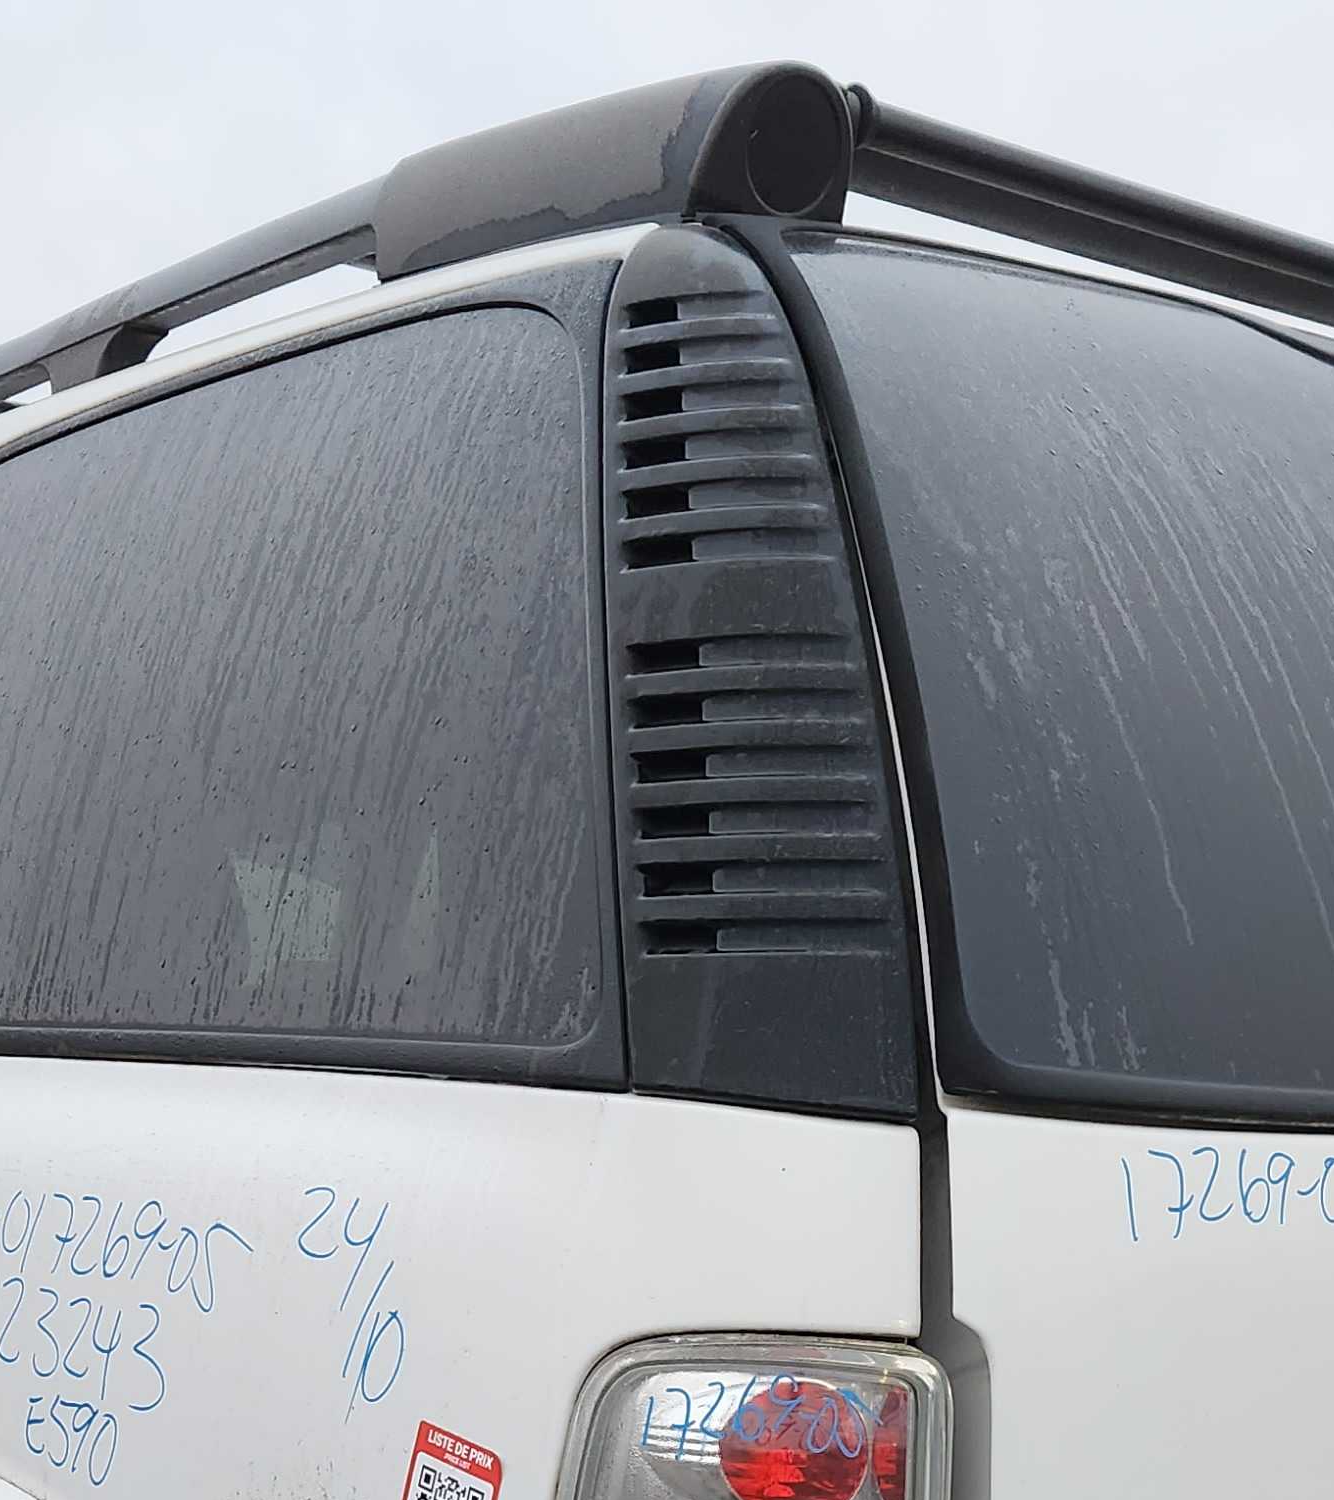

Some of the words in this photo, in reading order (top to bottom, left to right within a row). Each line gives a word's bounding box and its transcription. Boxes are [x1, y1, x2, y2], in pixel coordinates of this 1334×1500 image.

[26, 1394, 117, 1486] E590
[427, 1429, 455, 1453] LISTE
[454, 1441, 470, 1459] DE
[469, 1448, 494, 1470] PRIX
